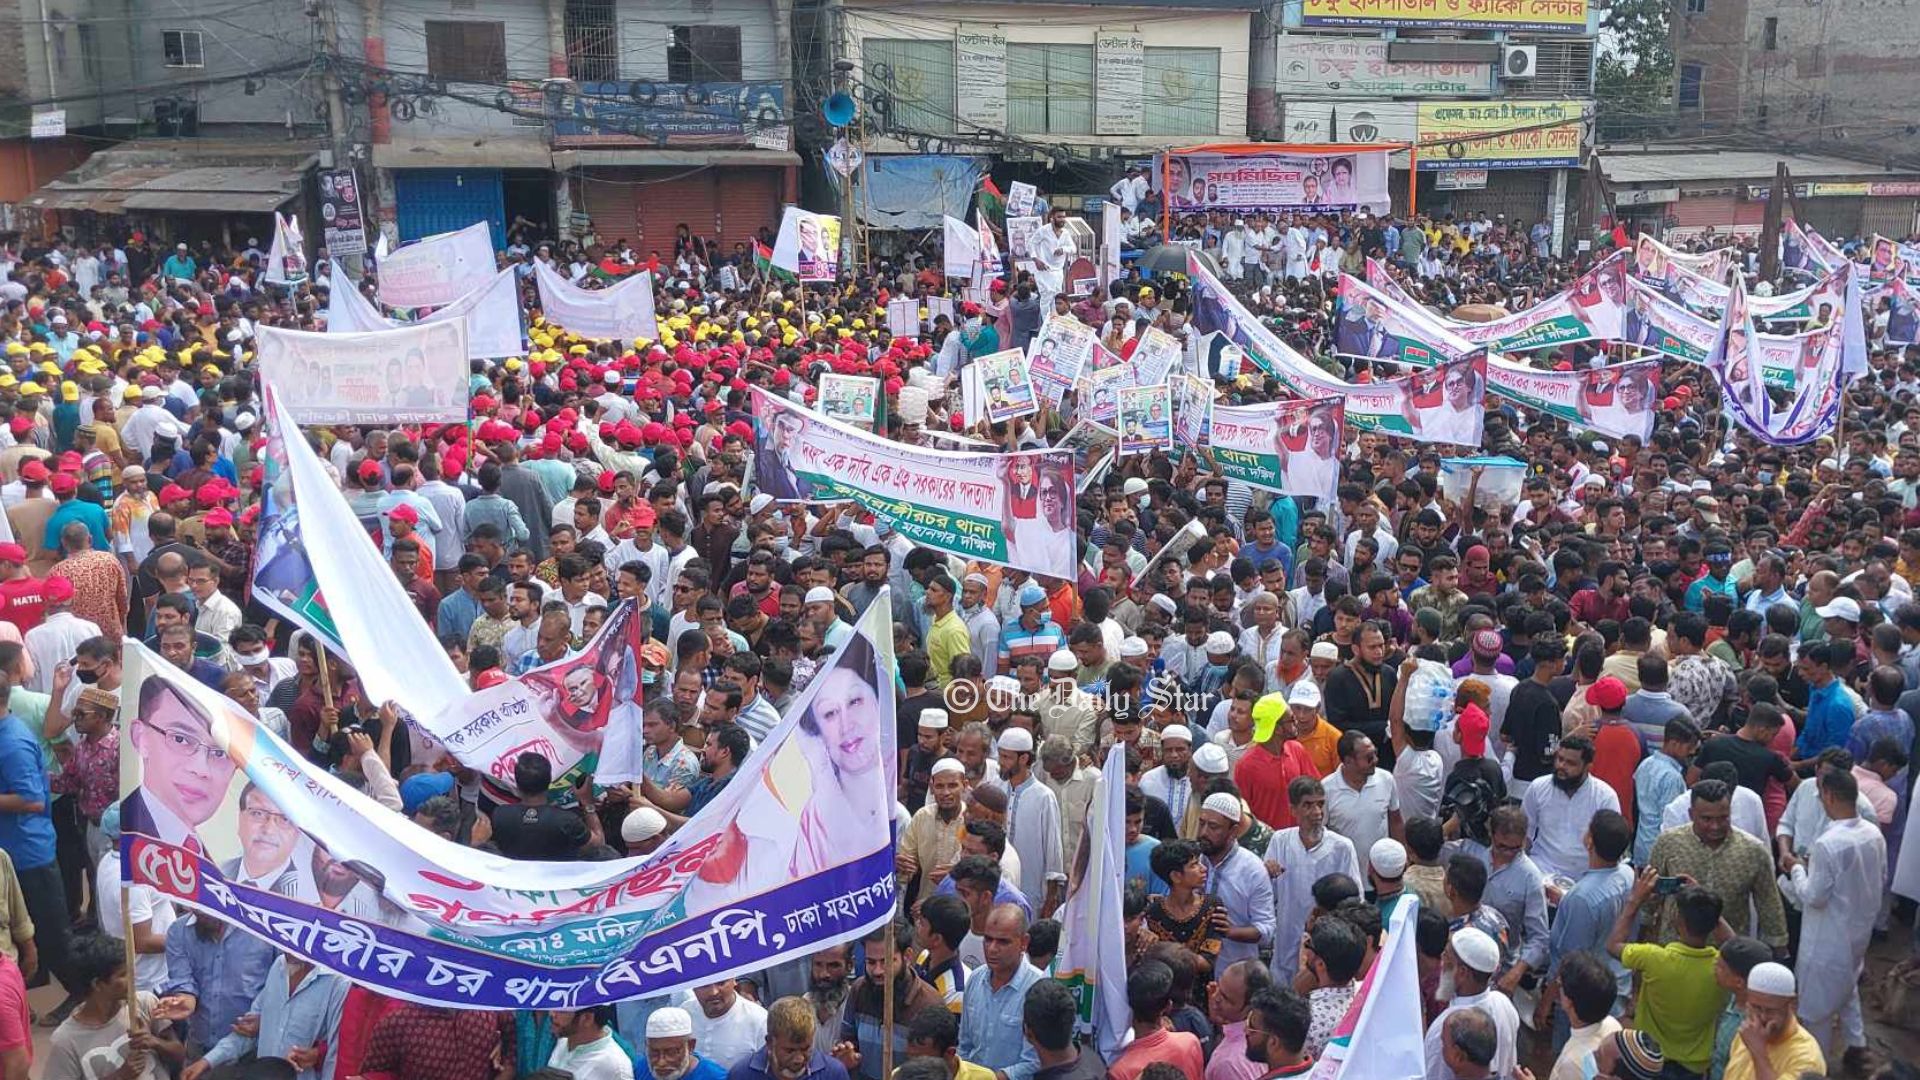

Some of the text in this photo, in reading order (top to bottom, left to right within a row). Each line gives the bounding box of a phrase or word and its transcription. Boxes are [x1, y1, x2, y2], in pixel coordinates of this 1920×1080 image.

[956, 517, 996, 540] থানা
[960, 531, 997, 555] দক্ষিণ
[139, 843, 196, 894] ৫৬
[426, 955, 495, 998] চর
[505, 974, 591, 1009] থানা
[783, 902, 822, 935] ঢাকা
